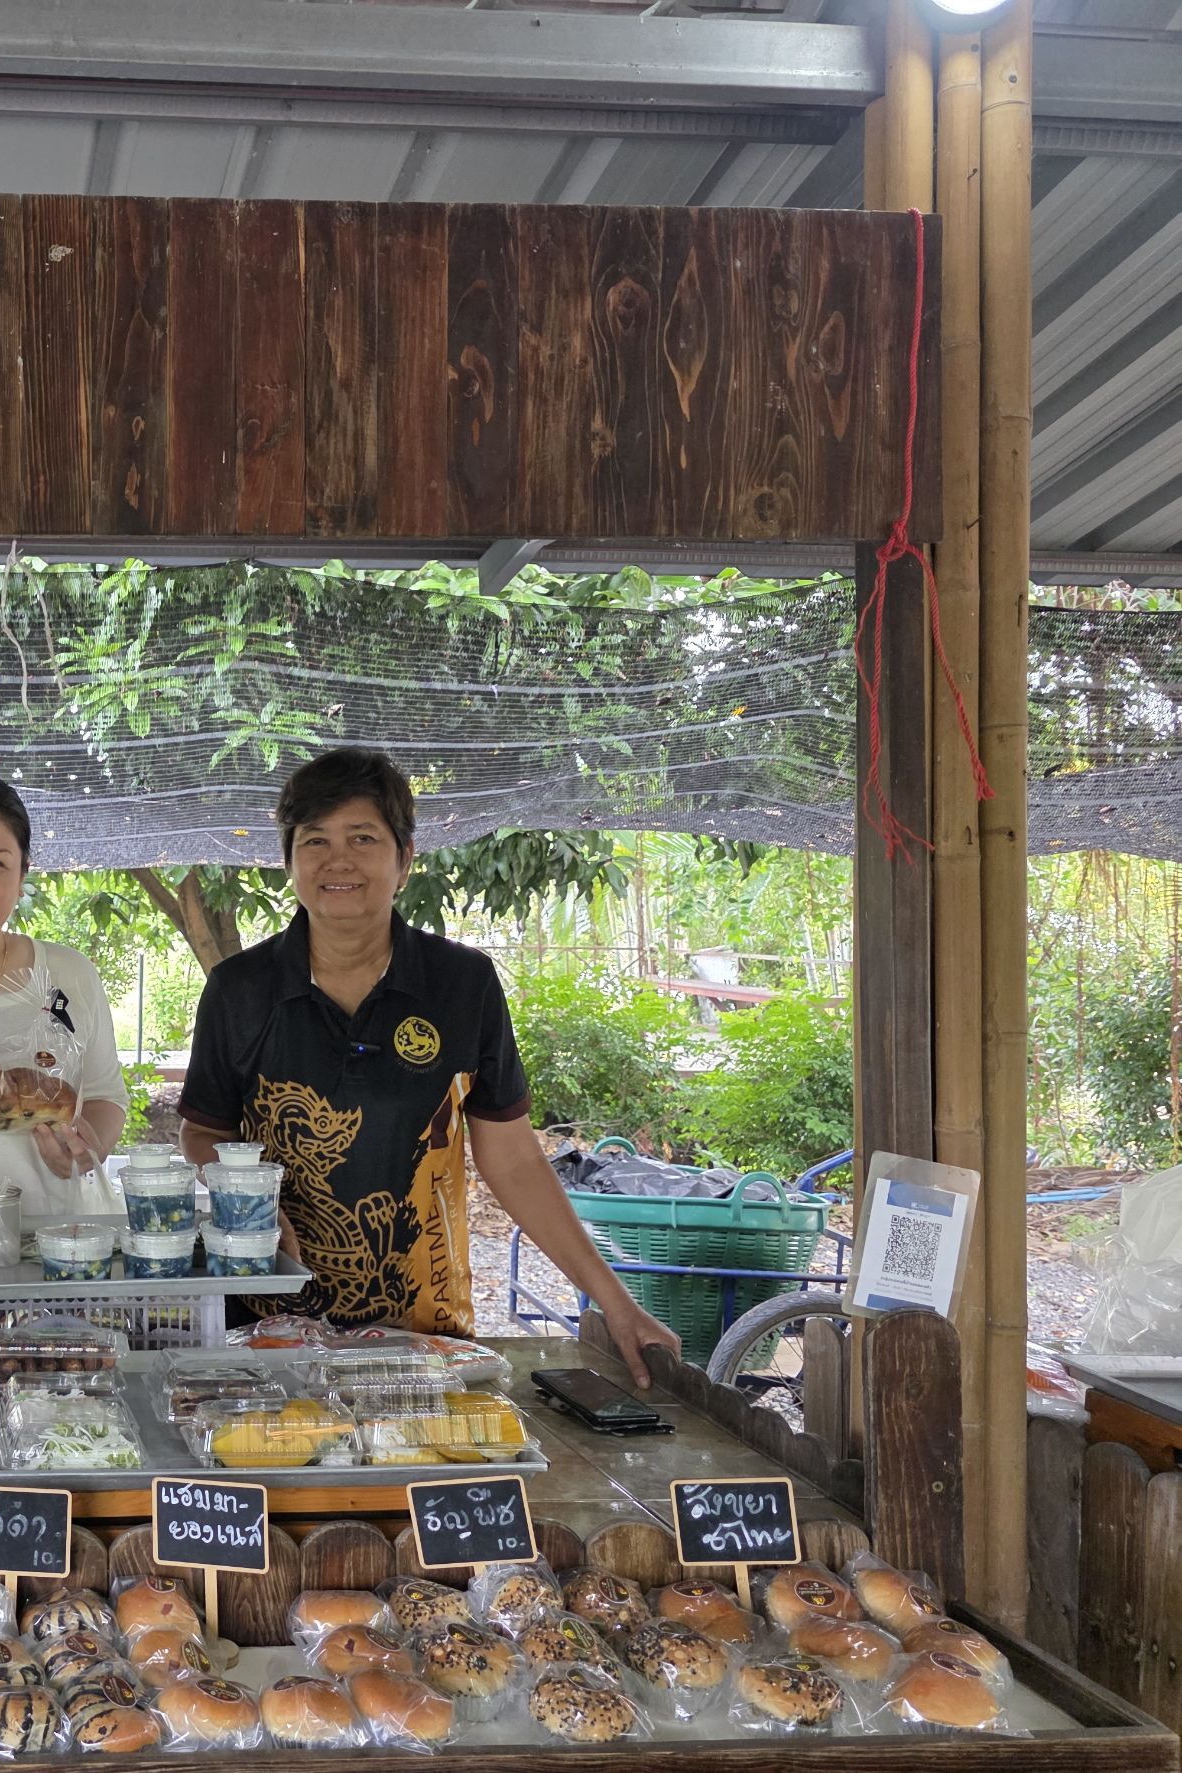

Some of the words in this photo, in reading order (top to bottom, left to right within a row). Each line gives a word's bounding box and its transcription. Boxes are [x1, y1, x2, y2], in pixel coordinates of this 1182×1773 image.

[423, 1487, 516, 1540] ธัญพืช
[683, 1484, 778, 1519] สังขยา
[702, 1520, 792, 1552] ชาไทย
